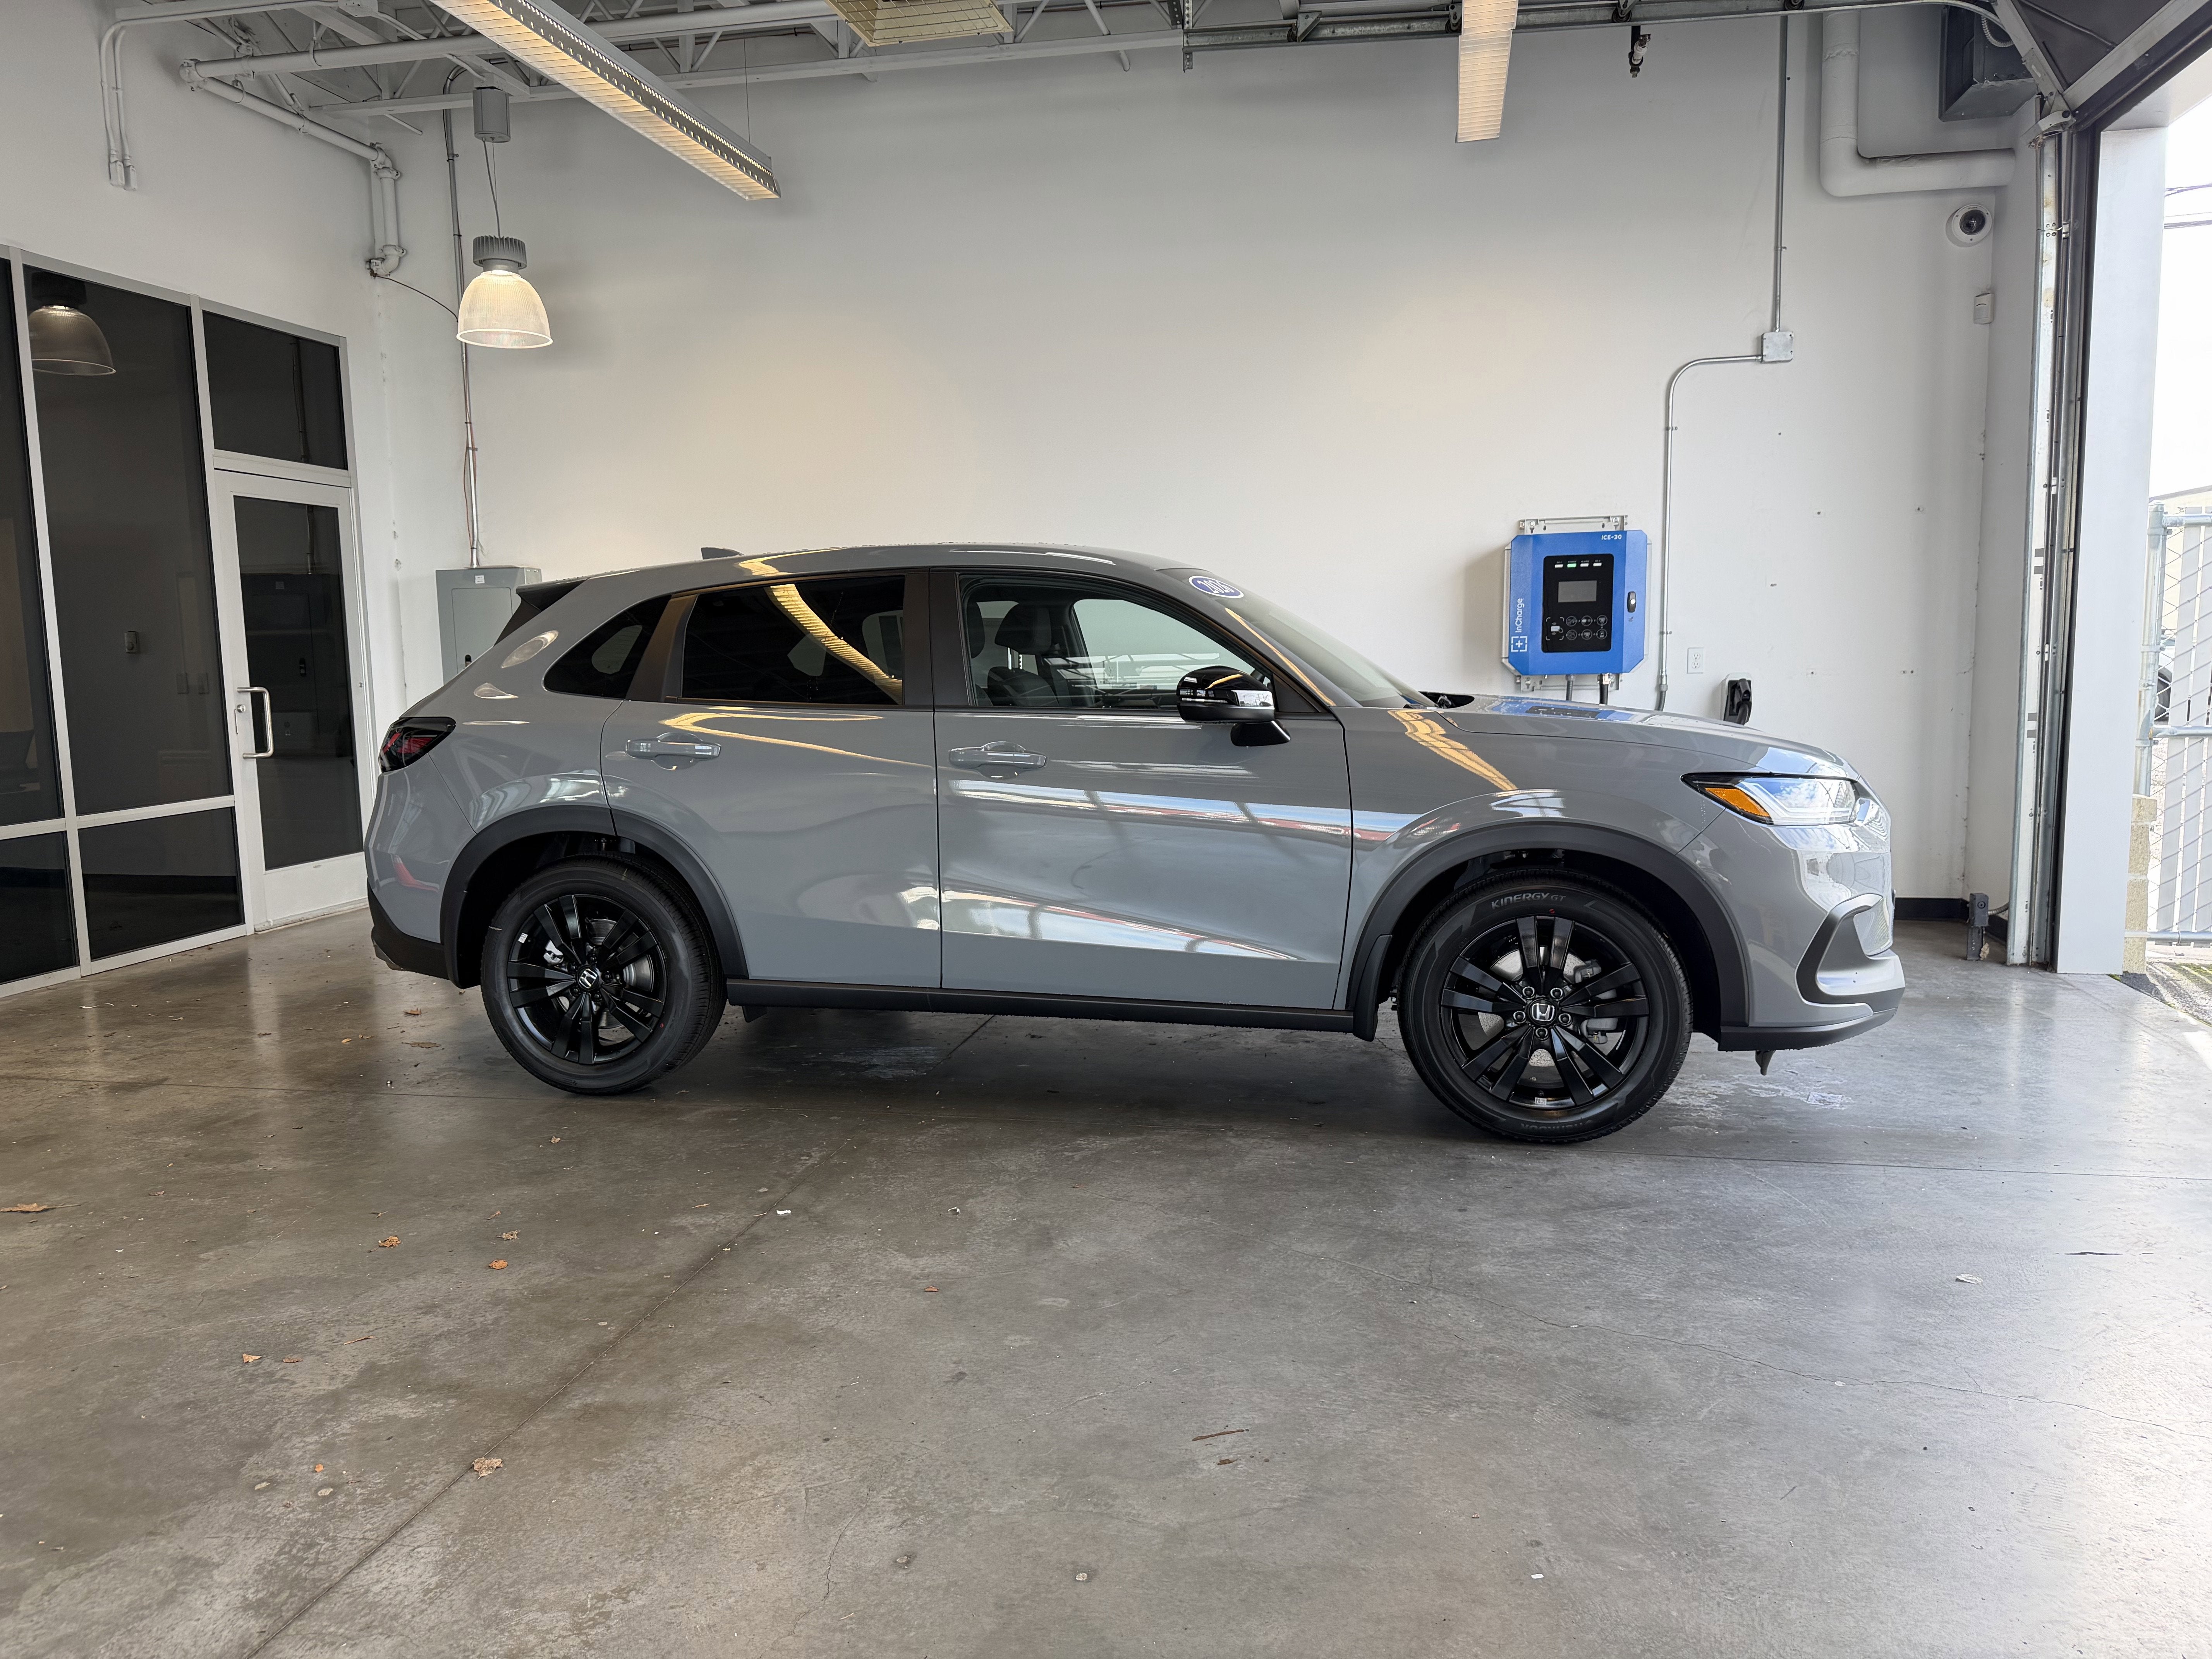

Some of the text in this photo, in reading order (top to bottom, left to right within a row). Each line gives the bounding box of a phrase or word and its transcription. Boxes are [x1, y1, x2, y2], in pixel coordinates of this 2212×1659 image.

[1197, 580, 1235, 594] 2026
[1515, 598, 1525, 633] InCharge
[1491, 892, 1550, 909] KINERGY
